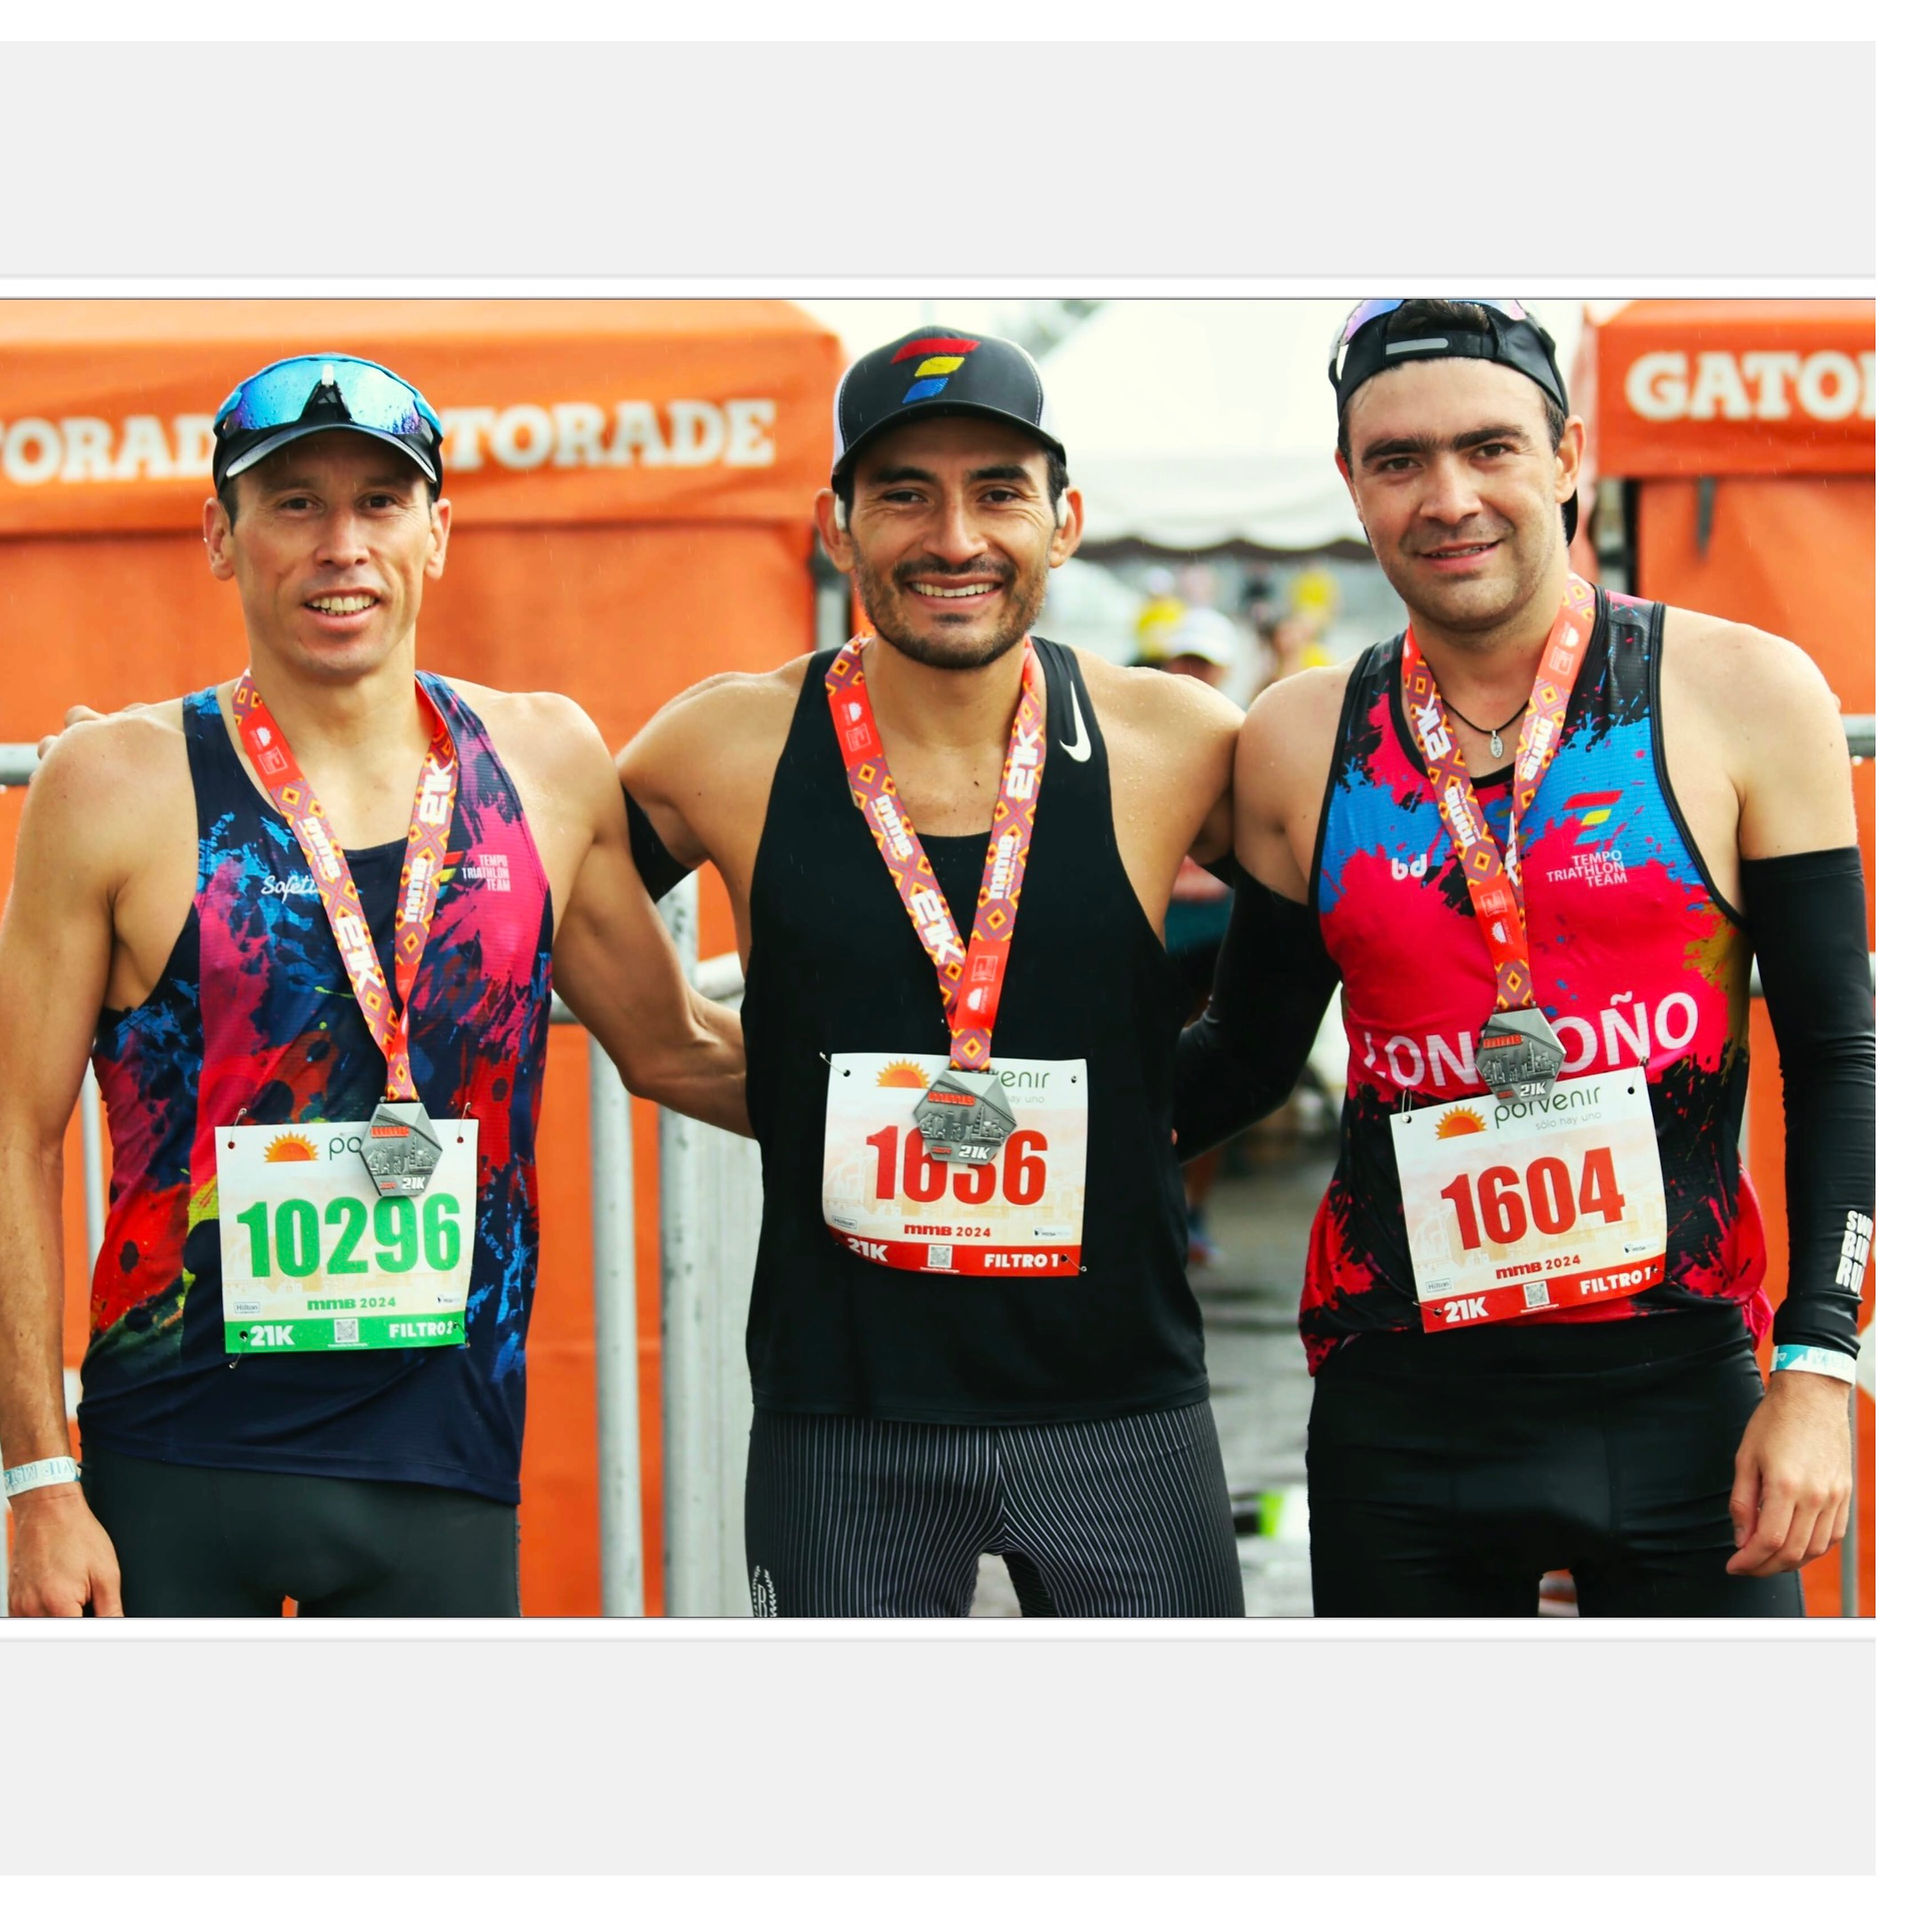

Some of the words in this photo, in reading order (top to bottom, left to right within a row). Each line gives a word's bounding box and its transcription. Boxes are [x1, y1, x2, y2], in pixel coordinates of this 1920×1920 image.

[0, 414, 216, 486] ORAD
[1006, 724, 1040, 799] 21K
[419, 758, 454, 824] 21K
[479, 854, 508, 867] TEMPO
[1571, 850, 1622, 867] TEMPO
[461, 867, 511, 881] TRIATHLON
[1546, 861, 1625, 883] TRIATHLON
[1586, 872, 1628, 888] TEAM
[486, 880, 512, 892] TEAM
[908, 888, 967, 963] 21K
[335, 915, 382, 993] 21K
[1363, 990, 1700, 1088] LONOÑO
[995, 1070, 1051, 1089] enir
[1520, 1082, 1548, 1097] 21K
[1025, 1096, 1045, 1104] uno
[1494, 1086, 1601, 1129] porvenir
[1559, 1114, 1578, 1127] hay
[1581, 1111, 1602, 1121] uno
[958, 1146, 991, 1160] 21K
[866, 1124, 1048, 1206] 1636
[402, 1177, 425, 1190] 21K
[1440, 1146, 1626, 1251] 1604
[237, 1192, 461, 1278] 10296
[956, 1226, 991, 1237] 2024
[847, 1237, 888, 1262] 21K
[984, 1253, 1048, 1268] FILTRO
[1051, 1253, 1059, 1268] 1
[1545, 1255, 1581, 1270] 2024
[1580, 1269, 1643, 1295] FILTRO
[360, 1297, 396, 1309] 2024
[1444, 1296, 1489, 1324] 21K
[250, 1325, 295, 1347] 21K
[389, 1321, 444, 1338] FILTRO
